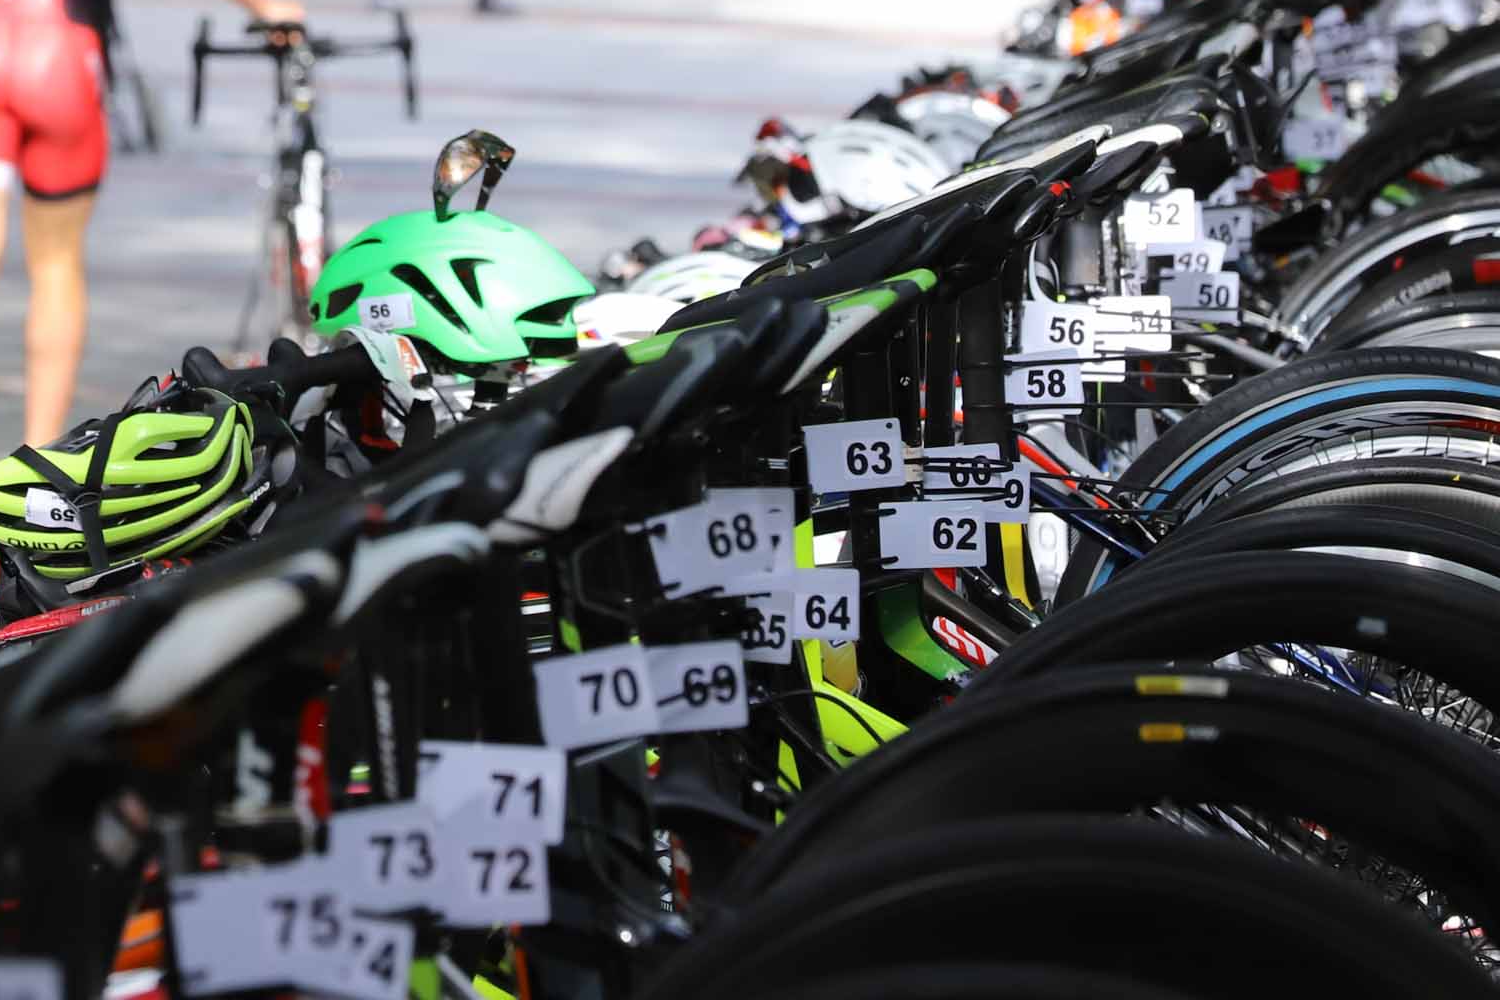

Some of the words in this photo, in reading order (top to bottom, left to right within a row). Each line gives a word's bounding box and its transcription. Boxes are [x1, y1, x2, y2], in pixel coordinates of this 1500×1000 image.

[1148, 203, 1181, 226] 52
[370, 303, 390, 319] 56
[1198, 284, 1230, 307] 50
[1049, 316, 1085, 346] 56
[1131, 309, 1164, 333] 54
[1027, 369, 1067, 399] 58
[846, 441, 893, 476] 63
[1004, 479, 1024, 508] 9
[50, 508, 76, 522] 59
[708, 513, 757, 558] 68
[933, 517, 978, 551] 62
[805, 595, 850, 631] 64
[580, 667, 640, 714] 70
[683, 664, 736, 703] 69
[492, 773, 543, 817] 71
[369, 832, 435, 883] 73
[471, 848, 532, 893] 72
[269, 893, 341, 949] 75
